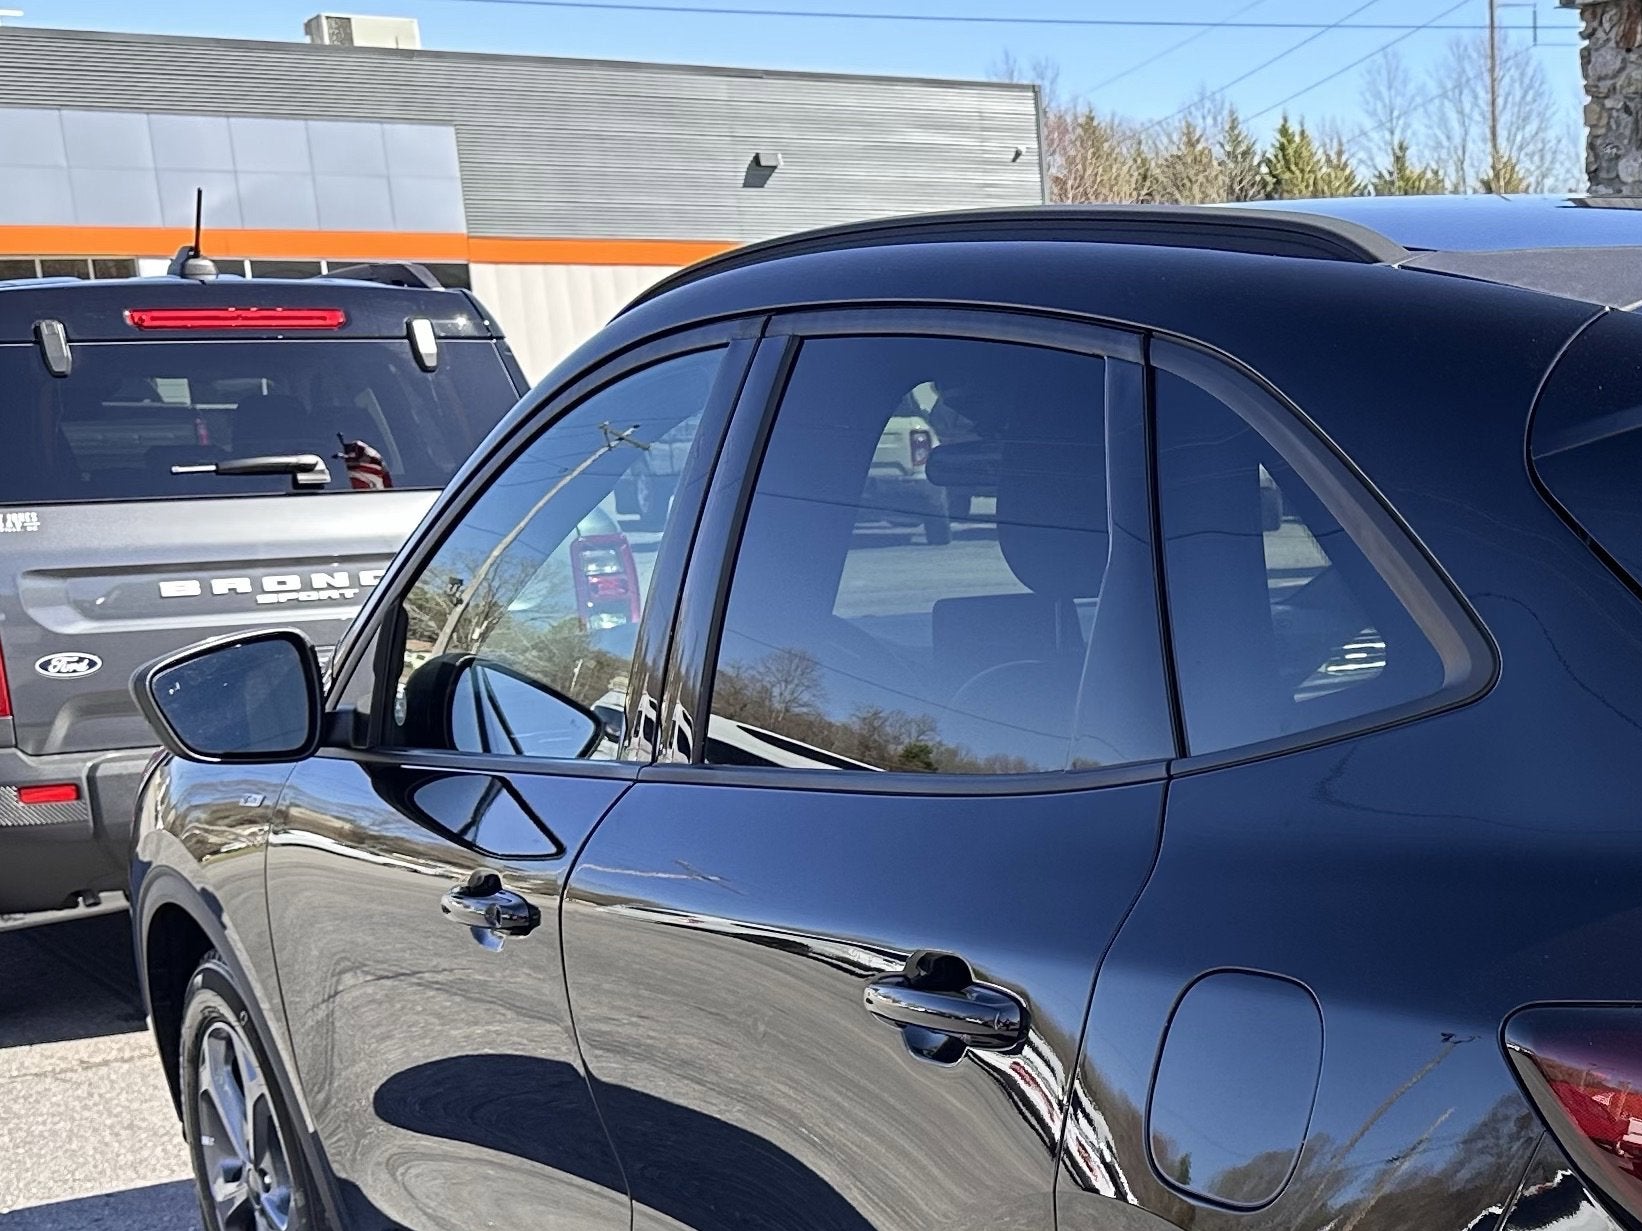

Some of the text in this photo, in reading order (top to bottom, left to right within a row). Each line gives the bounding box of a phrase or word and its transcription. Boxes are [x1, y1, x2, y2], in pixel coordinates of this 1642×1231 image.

[159, 569, 387, 598] BRONC
[256, 588, 359, 604] SPORT
[48, 656, 89, 673] Ford
